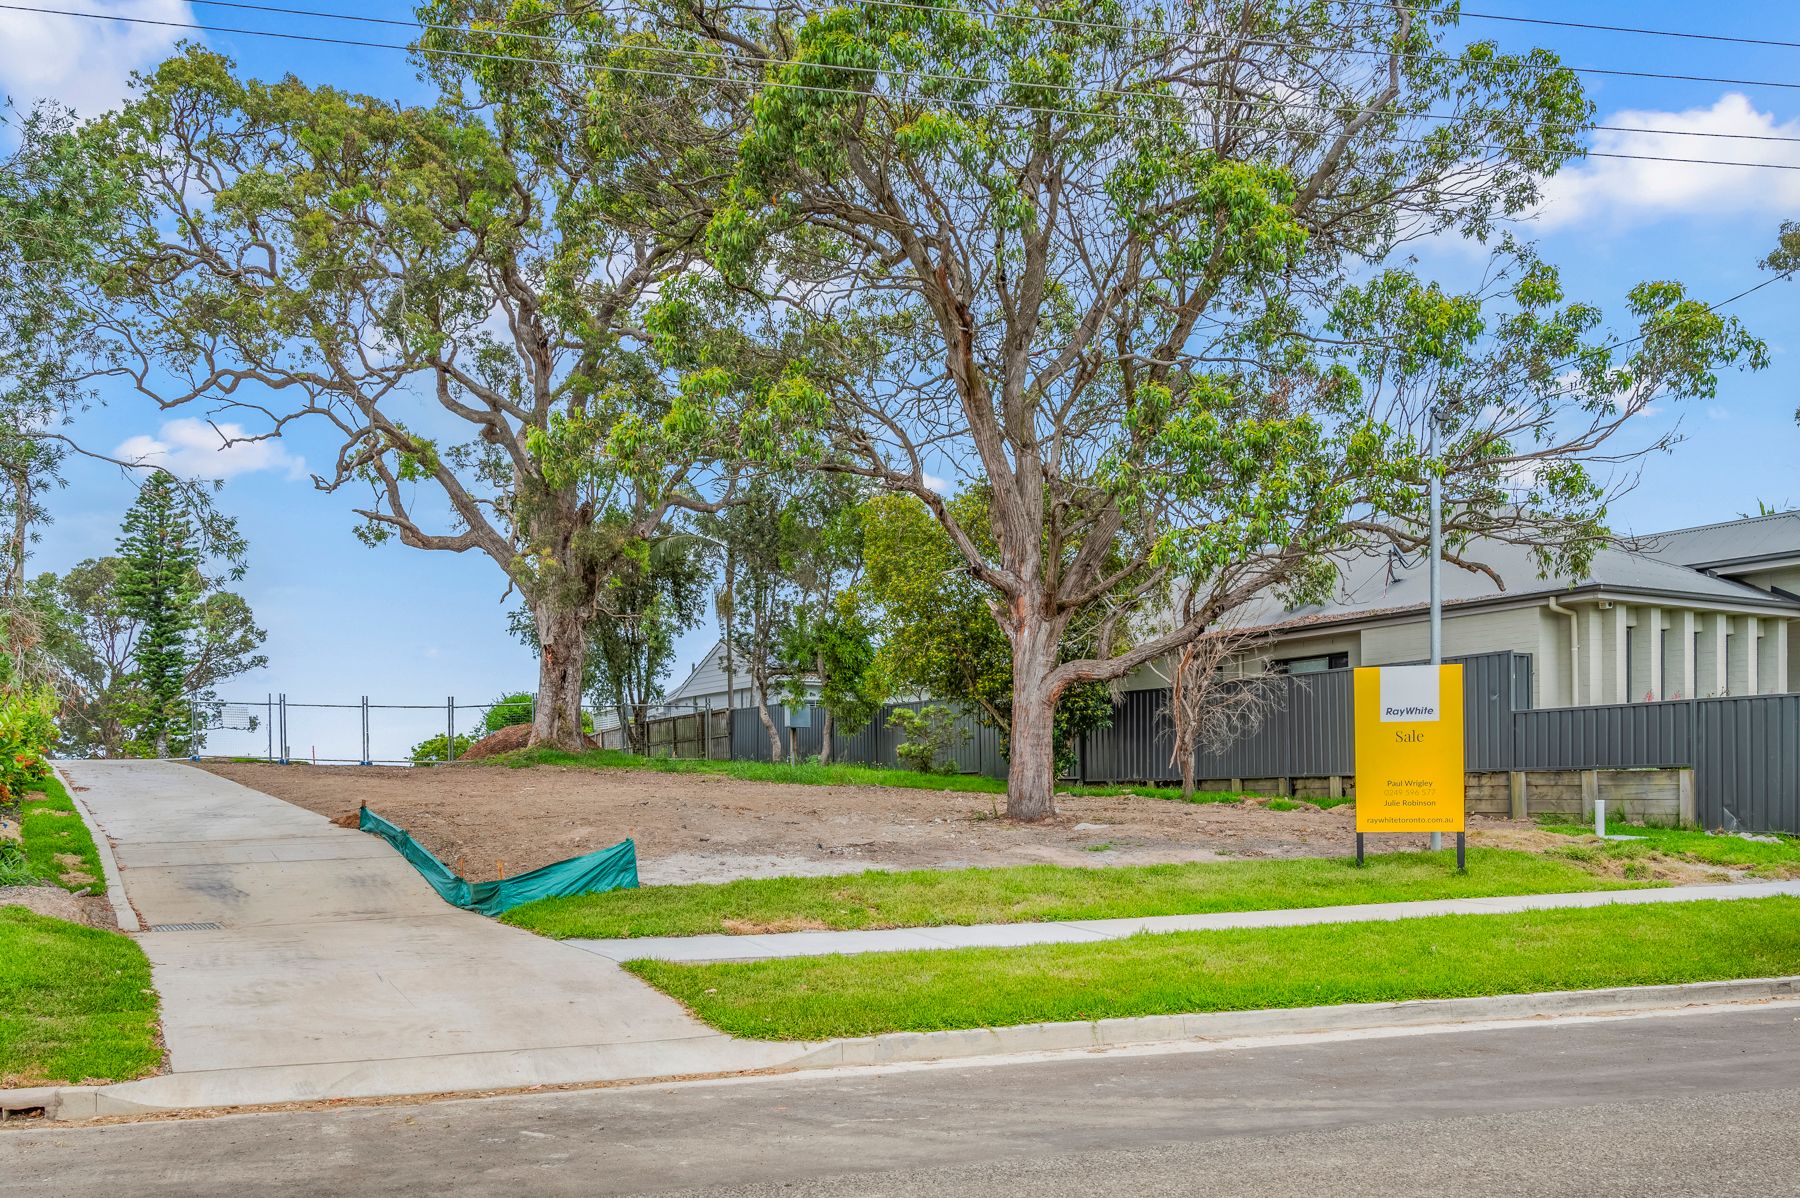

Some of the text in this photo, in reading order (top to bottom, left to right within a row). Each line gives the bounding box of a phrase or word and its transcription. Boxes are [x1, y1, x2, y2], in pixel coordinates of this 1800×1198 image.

[1385, 706, 1434, 717] RayWhite
[1395, 729, 1425, 743] Sale
[1404, 780, 1433, 788] Wrigley
[1383, 799, 1436, 807] Julie Robinson
[1366, 816, 1454, 824] raywhitetoronto.com.au
